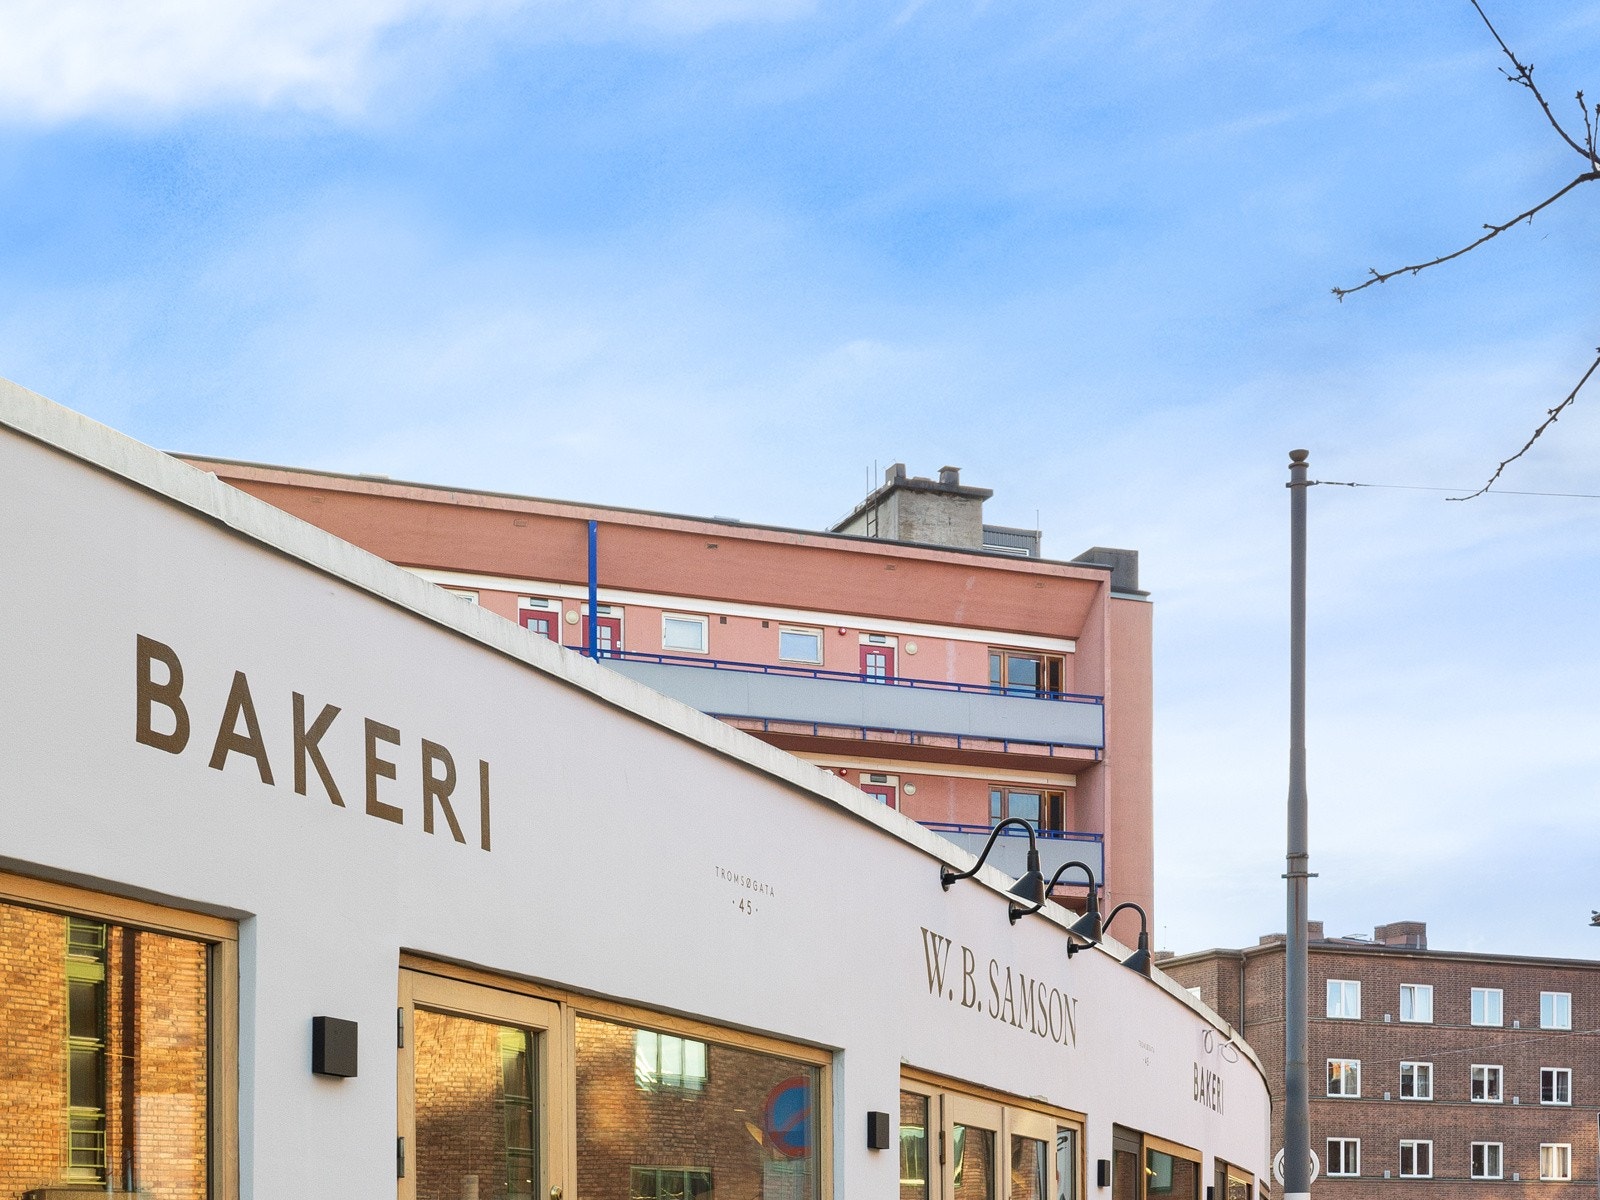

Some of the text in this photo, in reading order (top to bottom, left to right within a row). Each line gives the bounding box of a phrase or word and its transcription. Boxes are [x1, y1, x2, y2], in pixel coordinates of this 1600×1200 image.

[136, 633, 491, 852] BAKERI
[715, 865, 775, 898] TROMSØGATA
[988, 958, 1078, 1049] SAMSON
[1193, 1061, 1224, 1116] BAKERI
